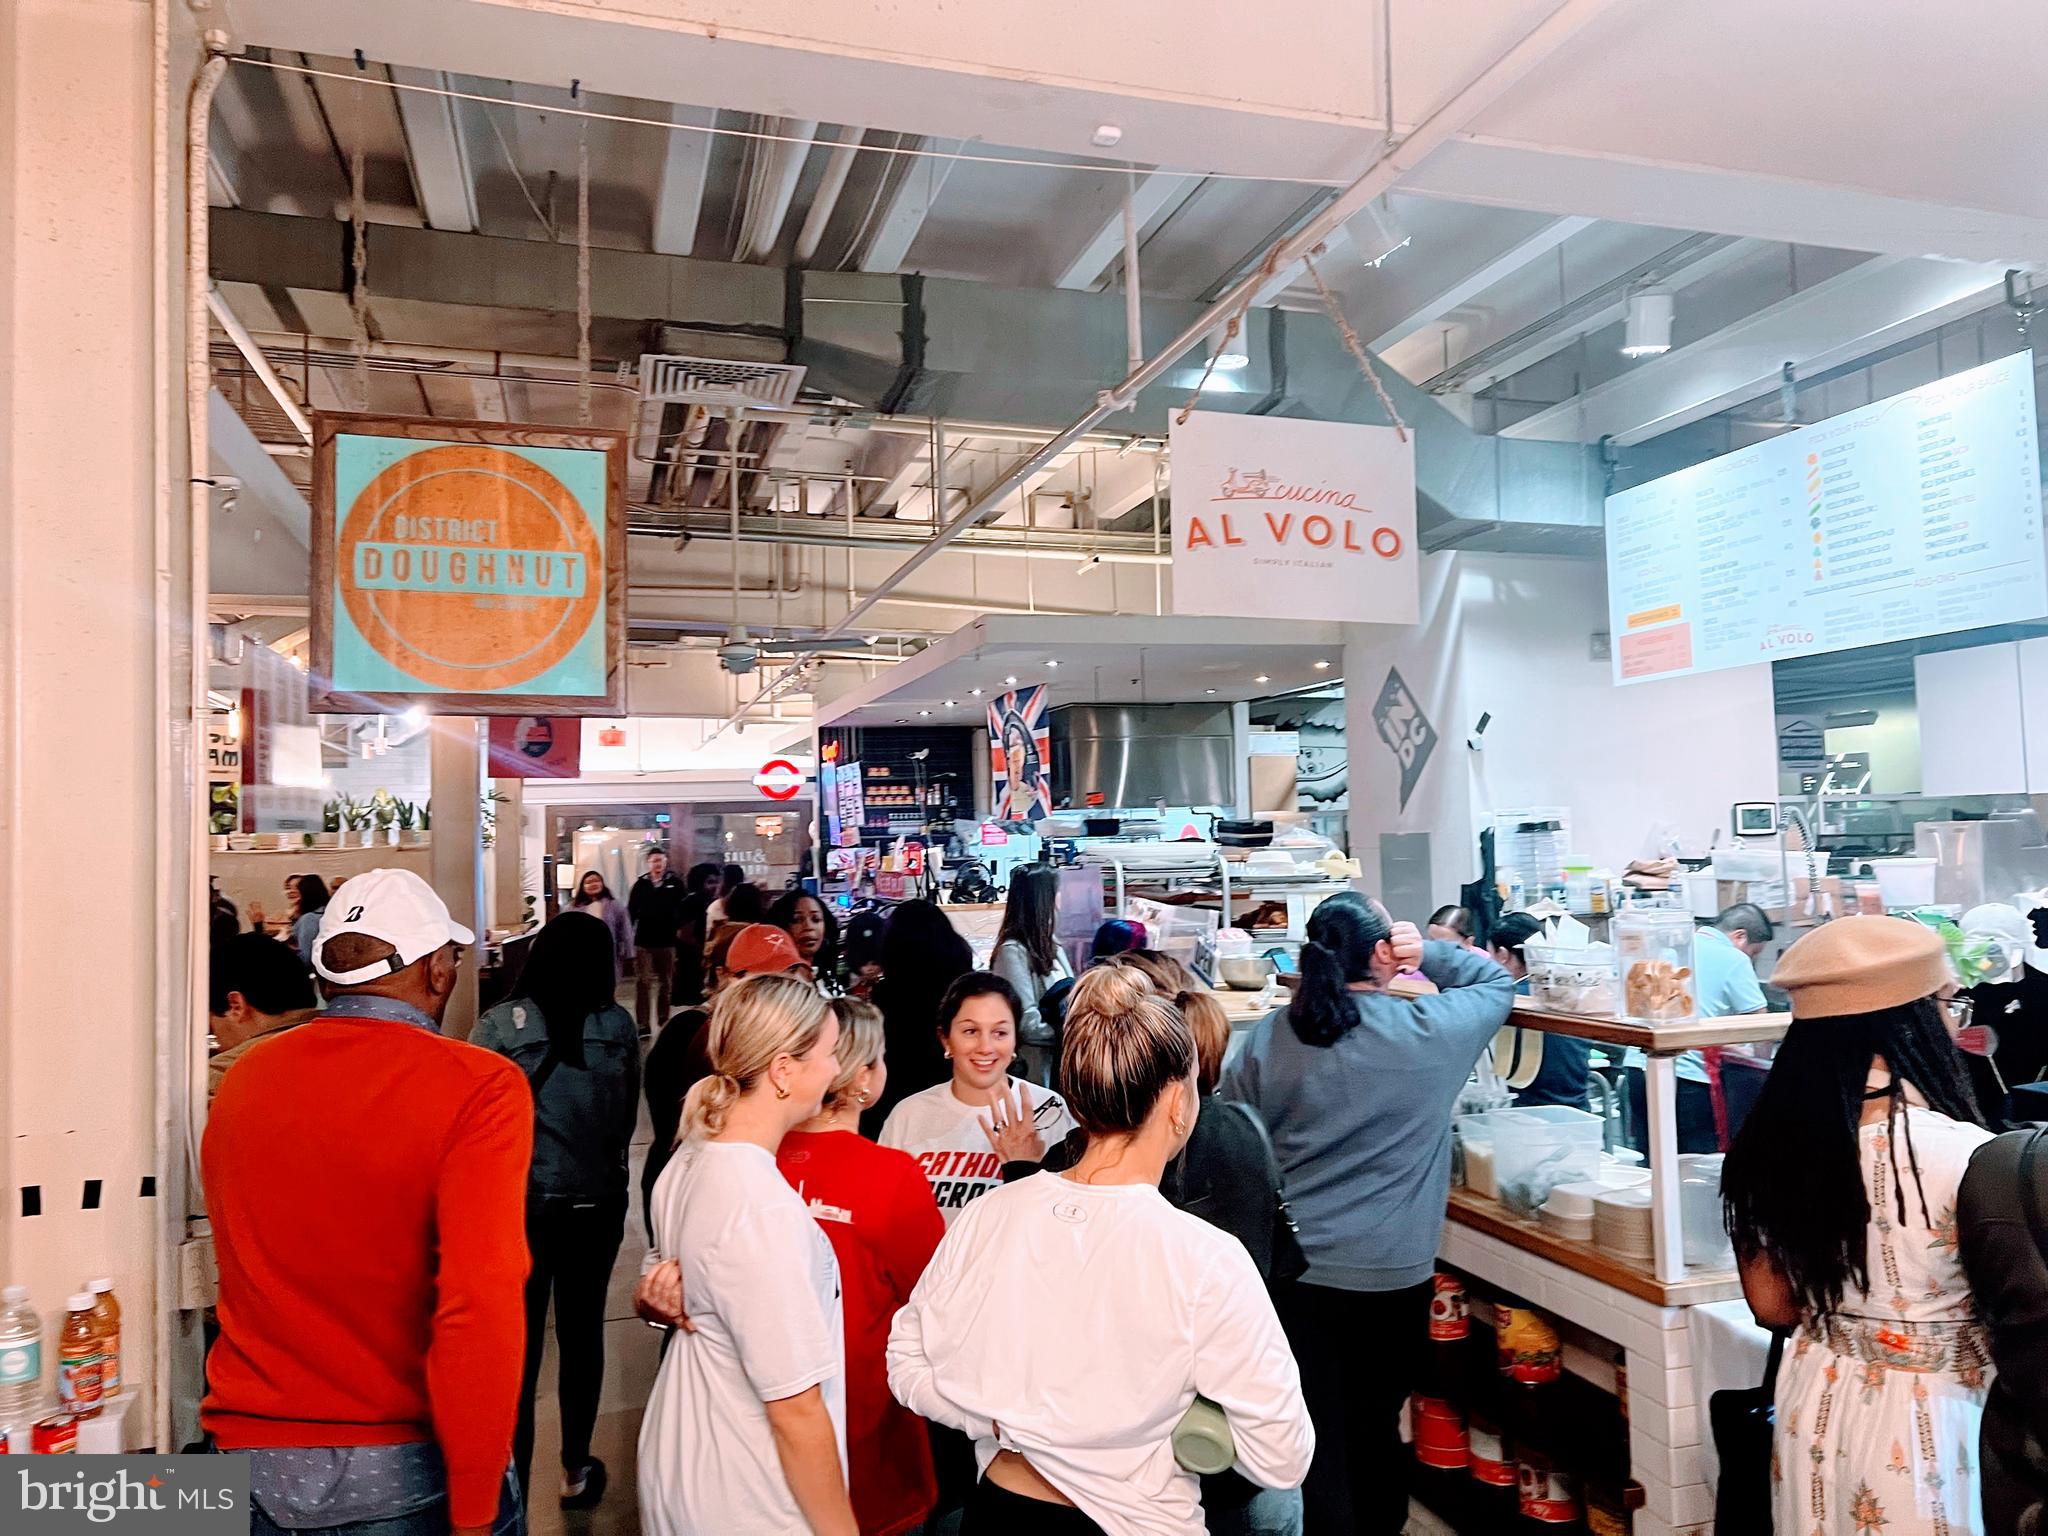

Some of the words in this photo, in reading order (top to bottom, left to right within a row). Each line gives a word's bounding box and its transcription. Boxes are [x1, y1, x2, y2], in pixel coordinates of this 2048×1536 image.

[1275, 480, 1372, 513] cucina
[394, 514, 498, 544] DISTRICT
[1187, 513, 1244, 551] AL
[1265, 512, 1403, 560] VOLO
[362, 547, 578, 589] DOUGHNUT
[1778, 632, 1814, 646] VOLO
[723, 852, 752, 863] SALT
